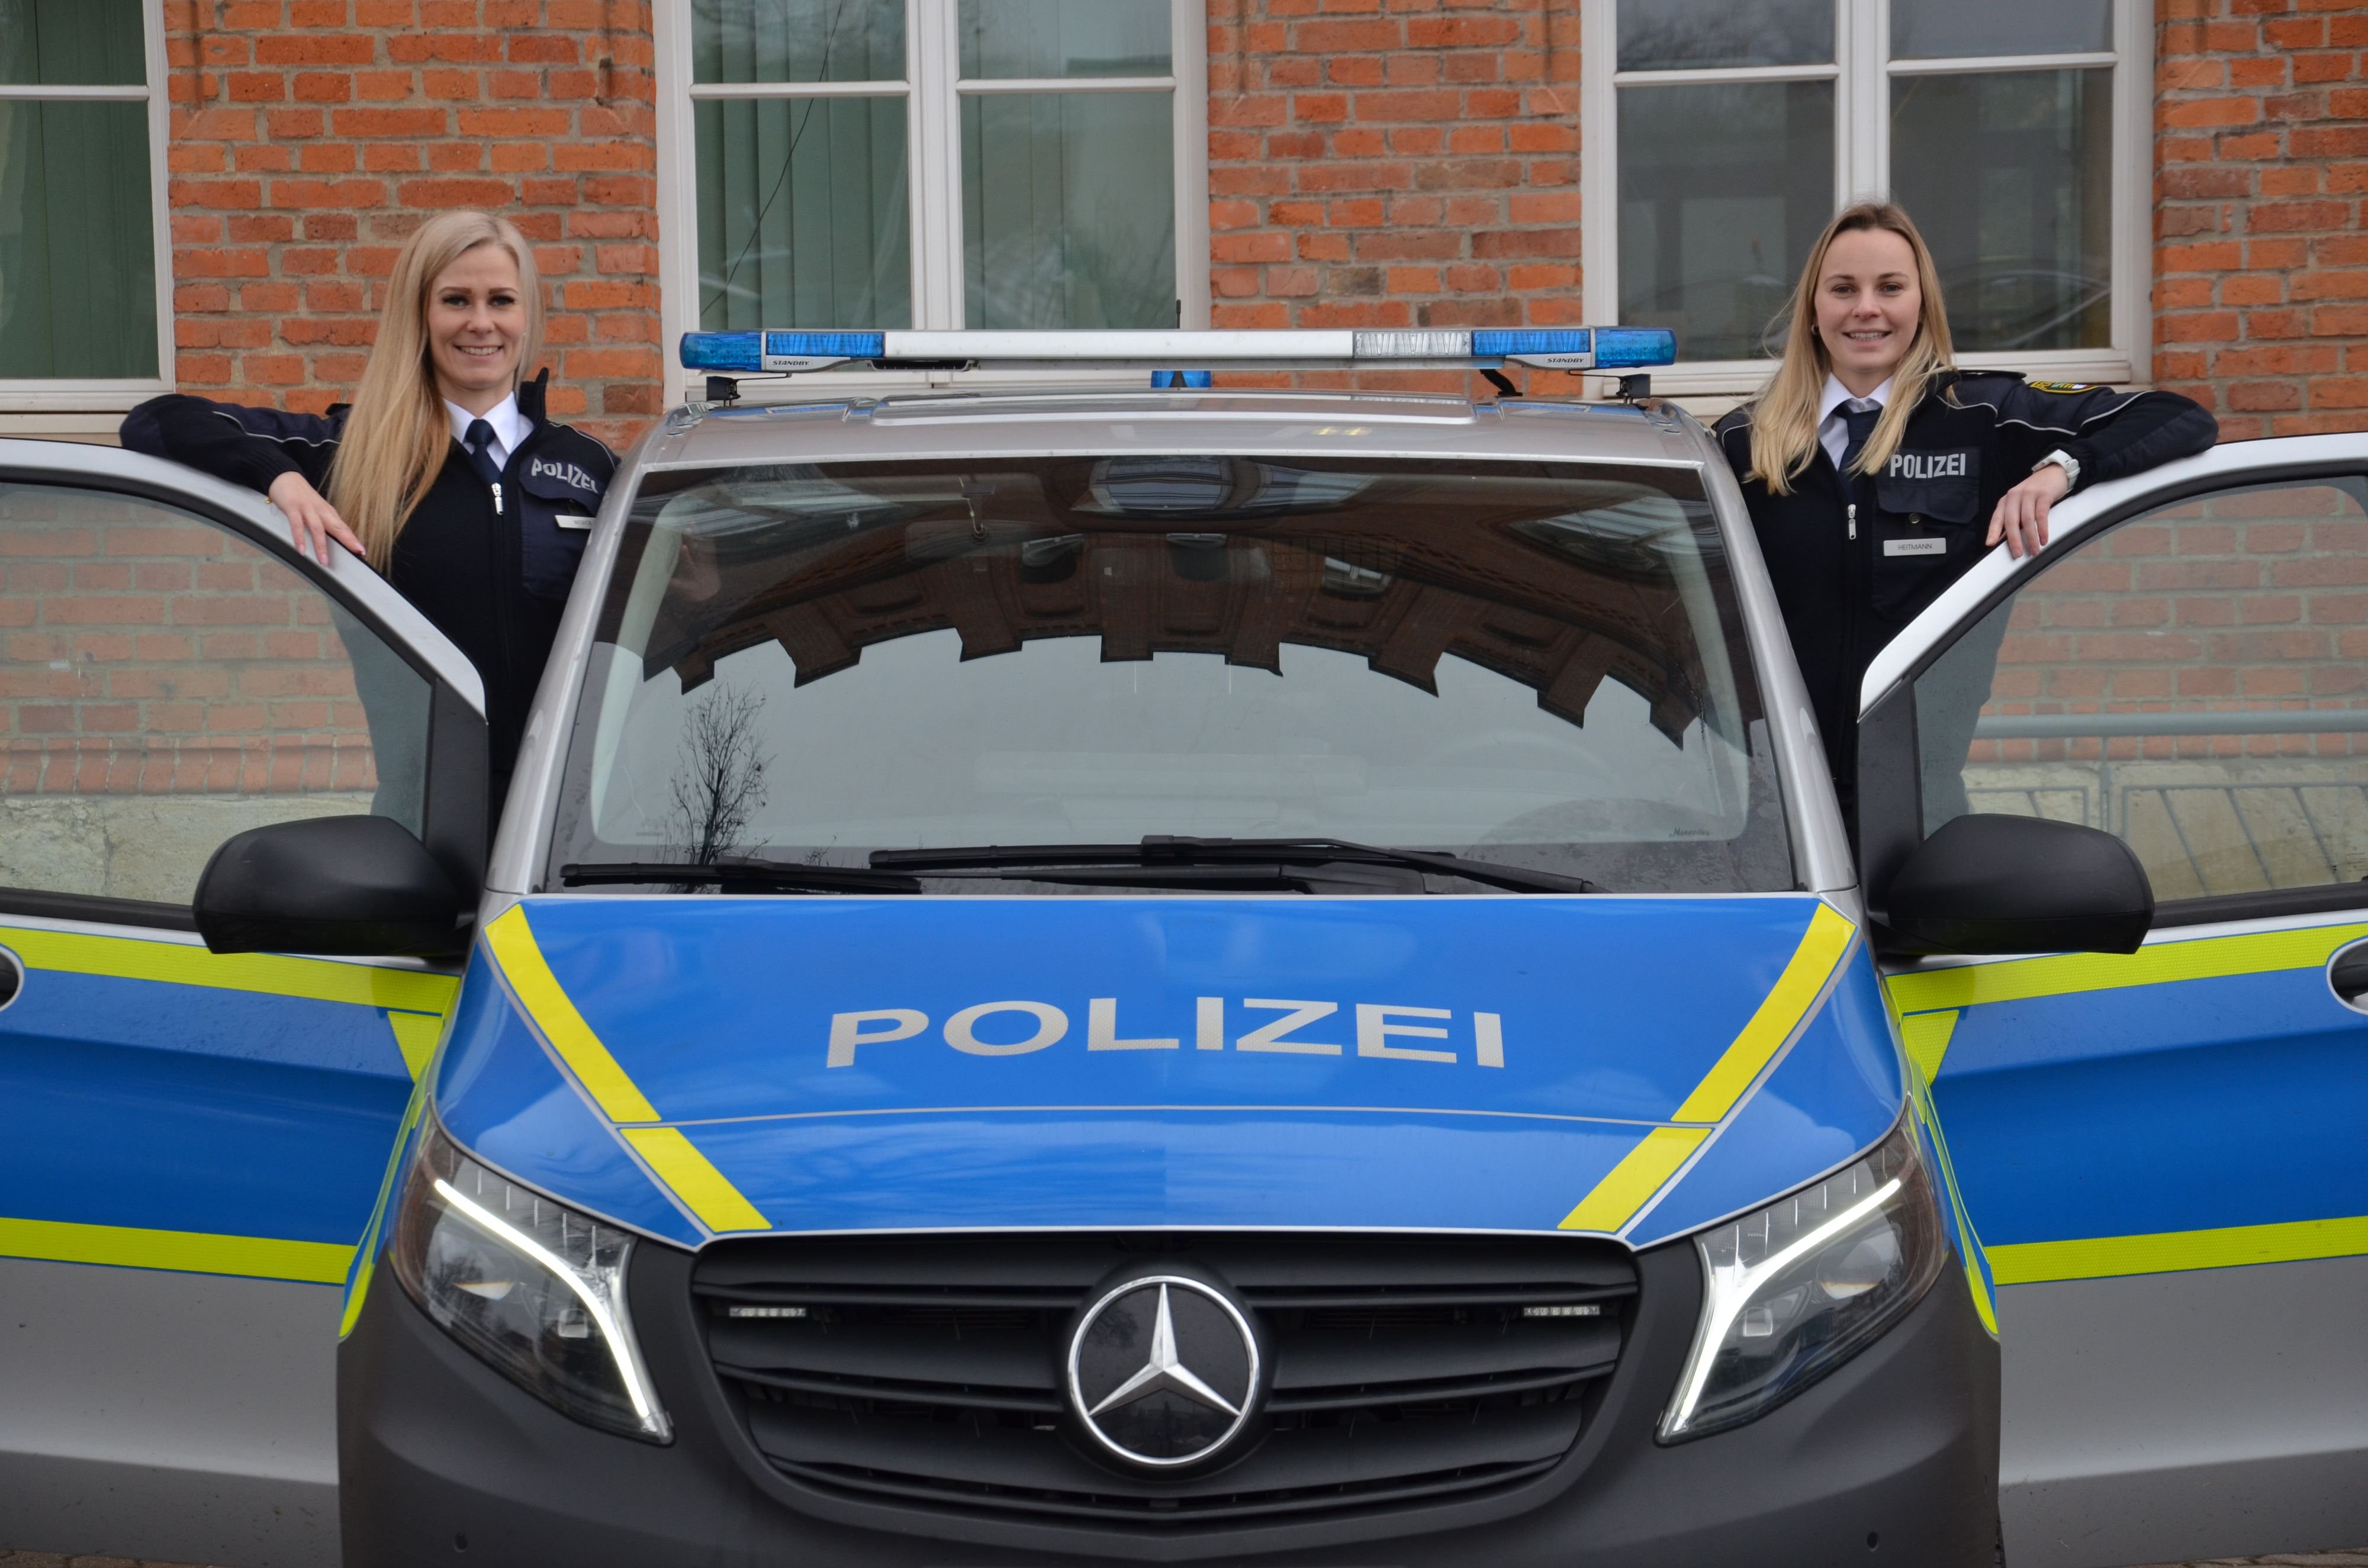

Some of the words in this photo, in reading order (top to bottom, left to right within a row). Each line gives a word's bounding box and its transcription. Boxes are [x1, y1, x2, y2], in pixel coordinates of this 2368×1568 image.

[531, 458, 598, 494] POLIZEI
[1890, 453, 1966, 478] POLIZEI
[826, 997, 1504, 1068] POLIZEI
